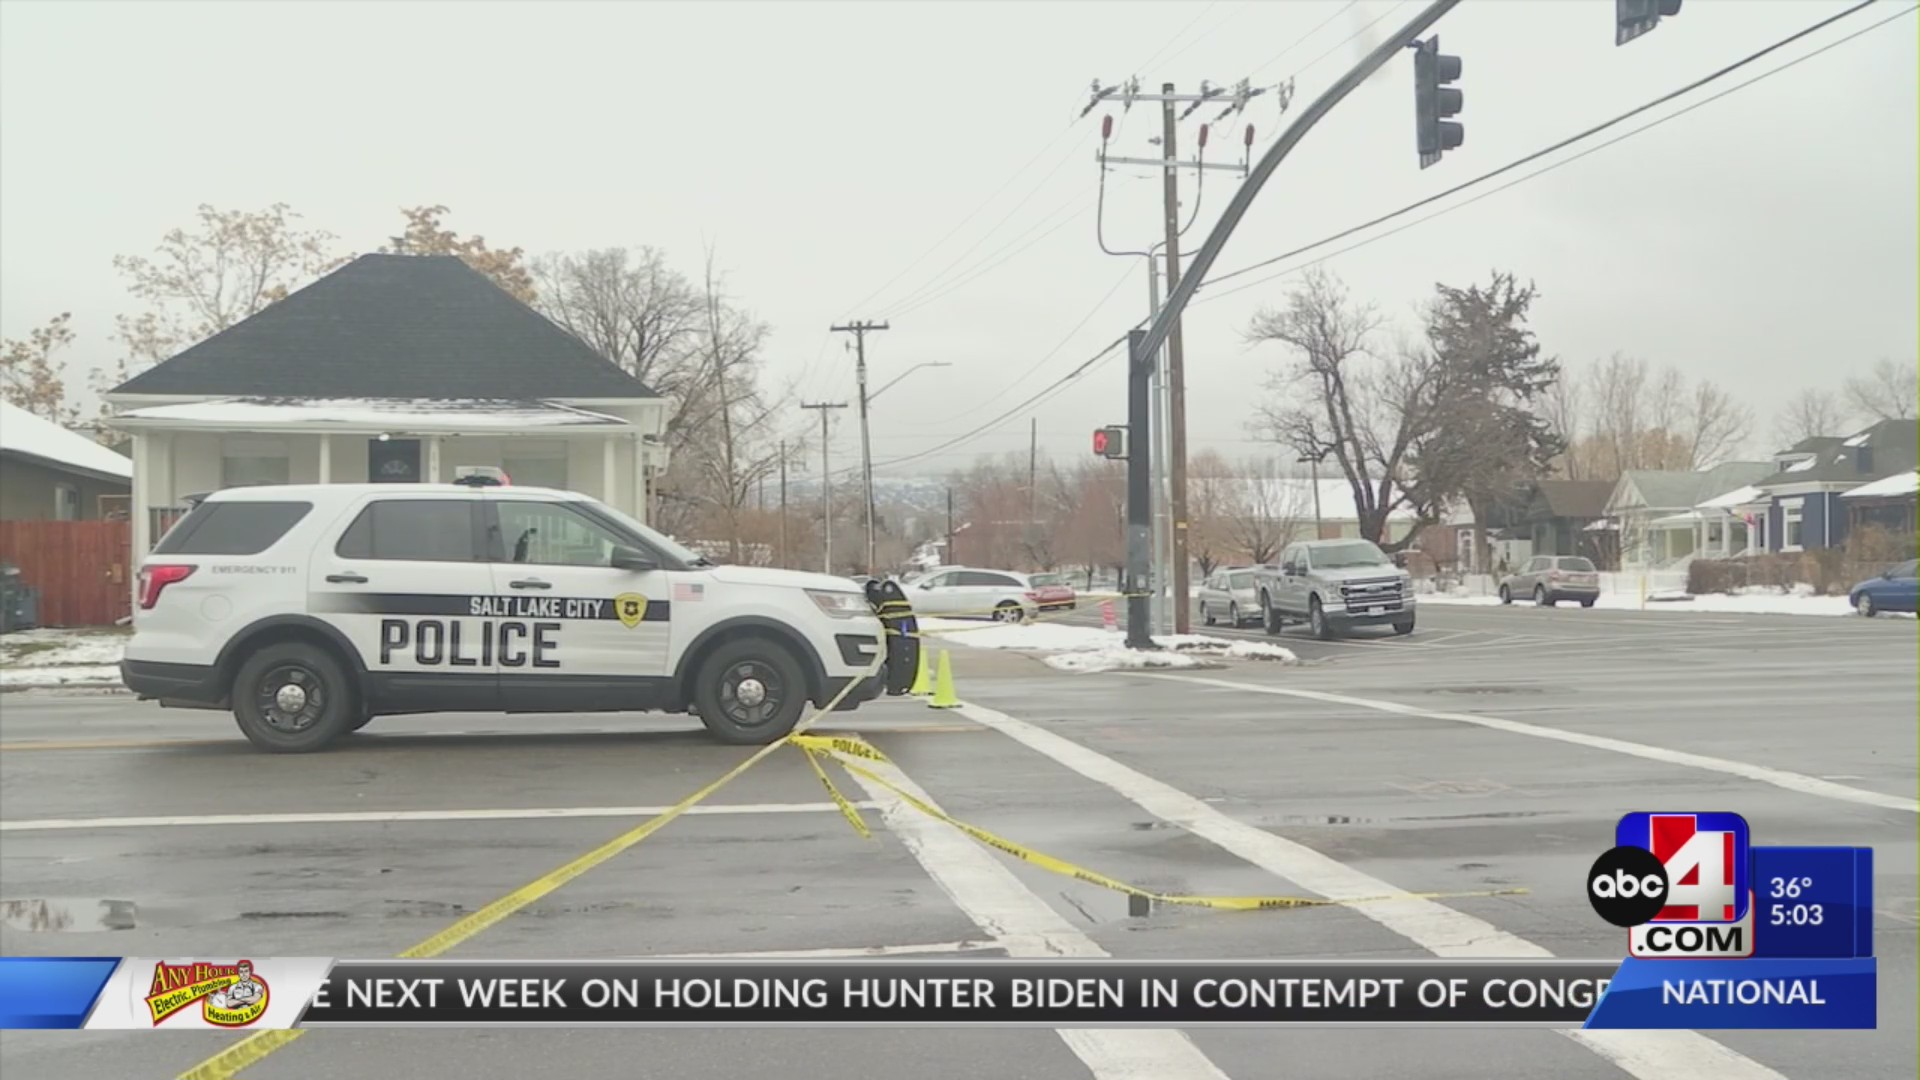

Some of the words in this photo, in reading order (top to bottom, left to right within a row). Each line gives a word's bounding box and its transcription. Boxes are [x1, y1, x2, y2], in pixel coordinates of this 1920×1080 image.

[211, 565, 278, 574] EMERGENCY
[470, 597, 513, 615] SALT
[516, 599, 562, 617] LAKE
[566, 600, 603, 618] CITY
[380, 619, 561, 668] POLICE
